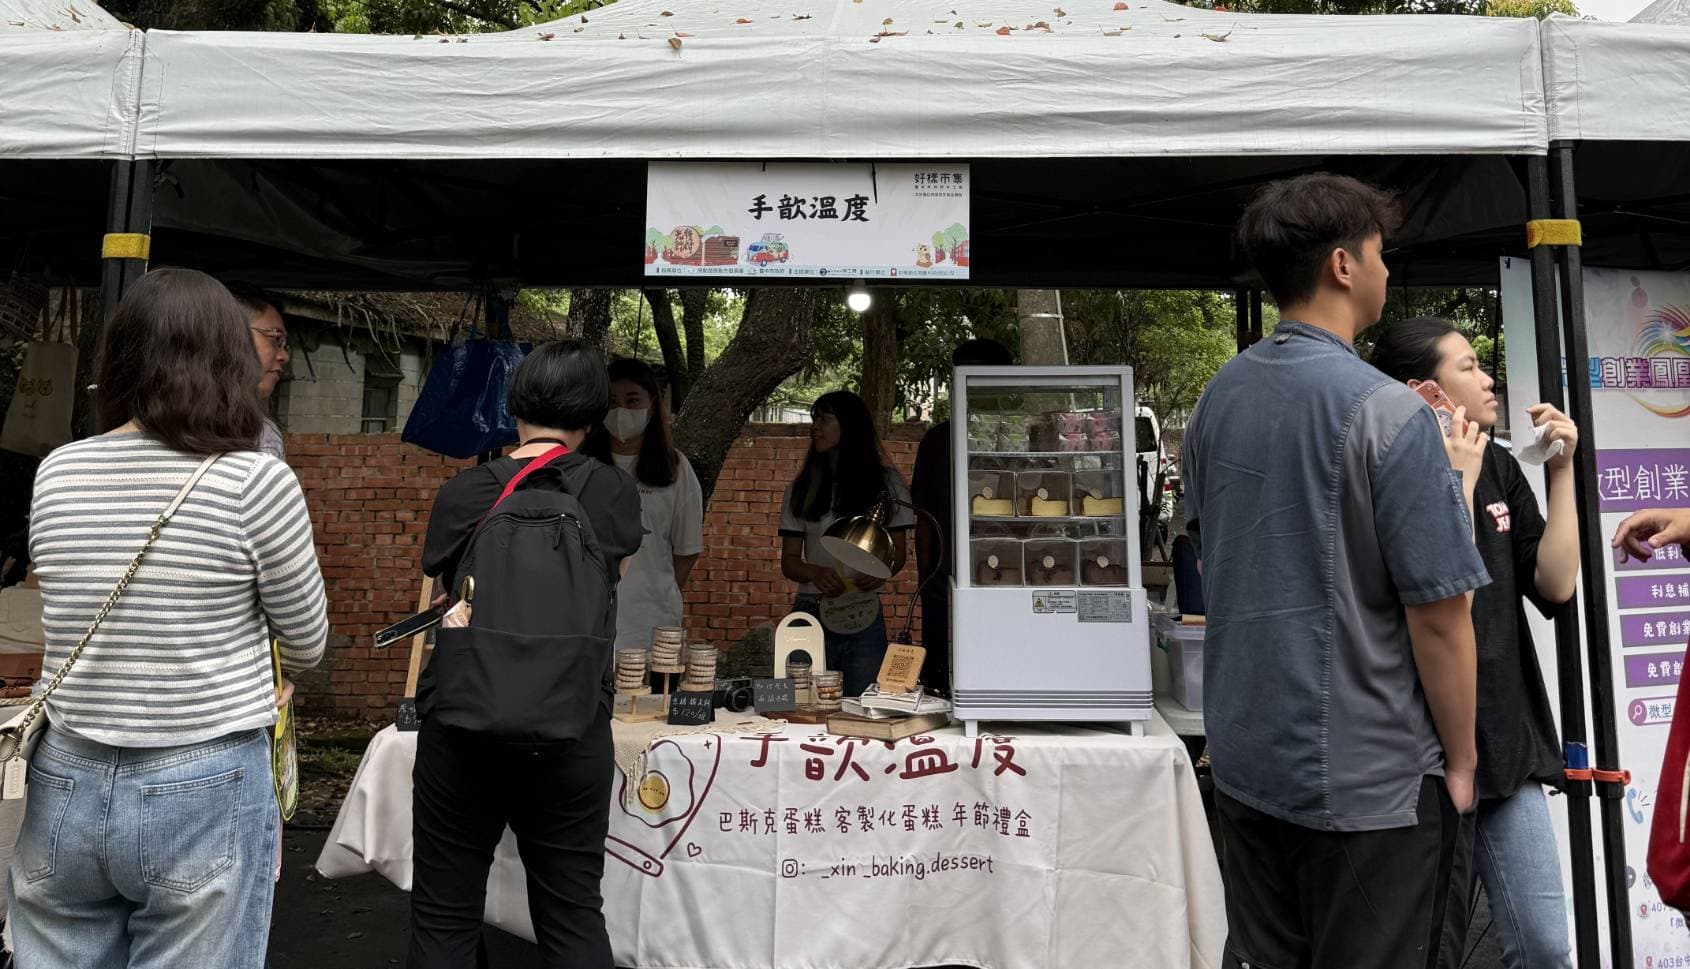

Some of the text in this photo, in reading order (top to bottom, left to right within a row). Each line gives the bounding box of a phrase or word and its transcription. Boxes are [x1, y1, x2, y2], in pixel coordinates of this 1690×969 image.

[748, 193, 870, 222] 手歆溫度
[1651, 582, 1690, 598] 利息補
[719, 801, 1032, 838] 巴斯克蛋糕 客製化蛋糕 年節禮盒
